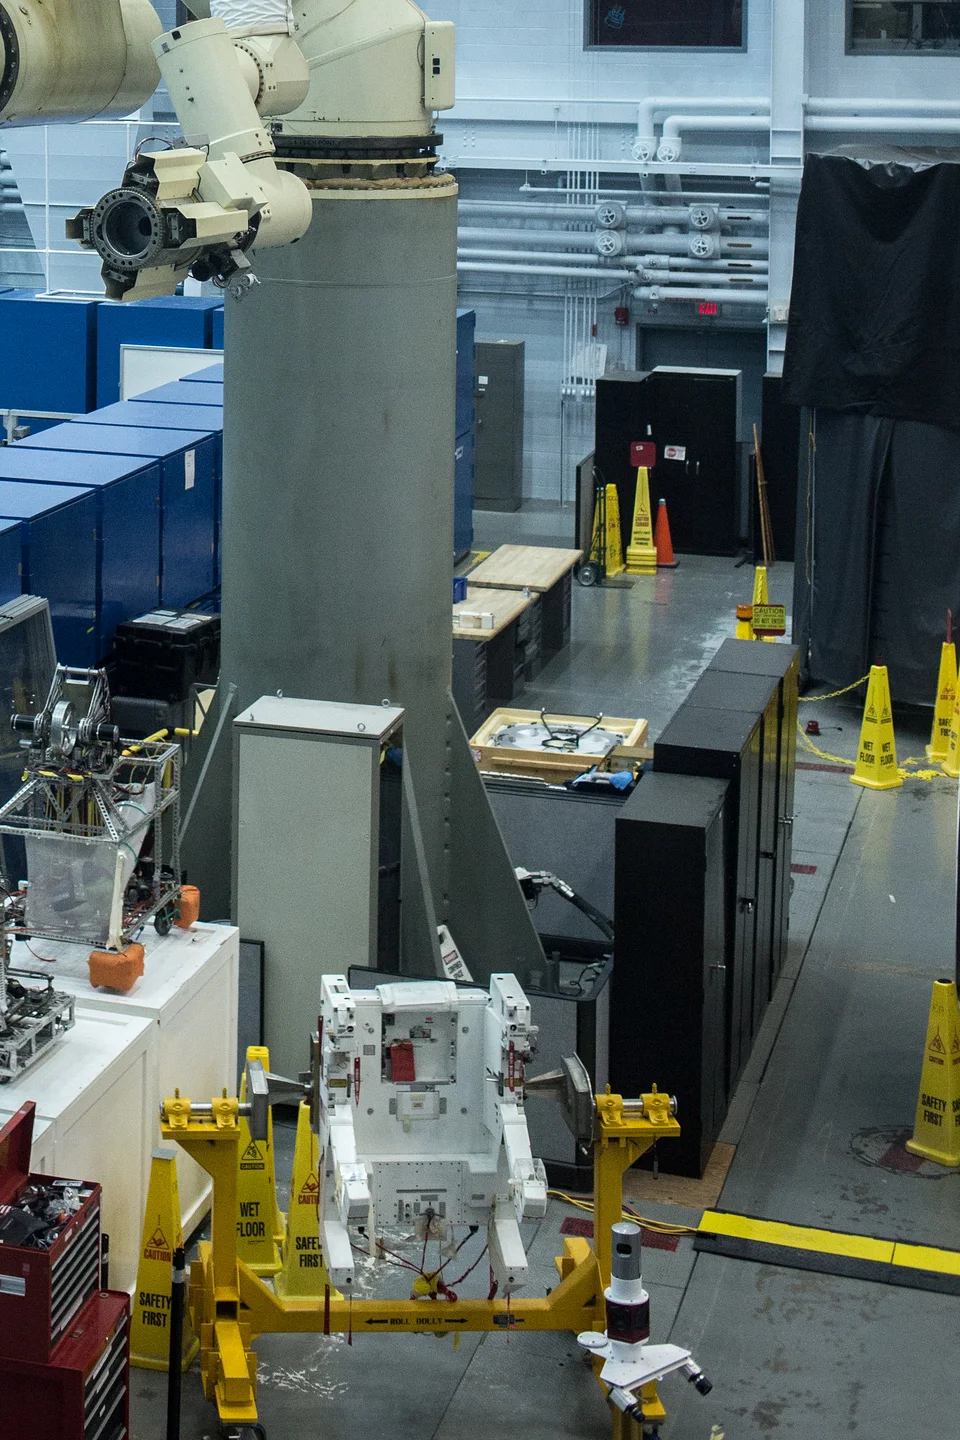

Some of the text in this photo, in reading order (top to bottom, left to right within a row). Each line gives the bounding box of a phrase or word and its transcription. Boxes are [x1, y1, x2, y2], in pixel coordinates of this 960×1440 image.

[699, 303, 717, 314] EXIT
[754, 607, 784, 615] CAUTION
[938, 718, 952, 727] SAFE
[863, 741, 873, 751] WET
[882, 742, 890, 752] WET
[860, 752, 875, 764] FLOOR
[881, 754, 894, 766] FLOOR
[921, 1093, 946, 1112] SAFETY
[923, 1109, 943, 1126] FIRST
[240, 1202, 260, 1217] WET
[296, 1236, 322, 1250] SAFET
[143, 1248, 172, 1262] CAUTION
[300, 1254, 323, 1268] FIRST
[140, 1292, 172, 1309] SAFETY
[143, 1310, 167, 1327] FIRST
[416, 1317, 443, 1325] DOLLY
